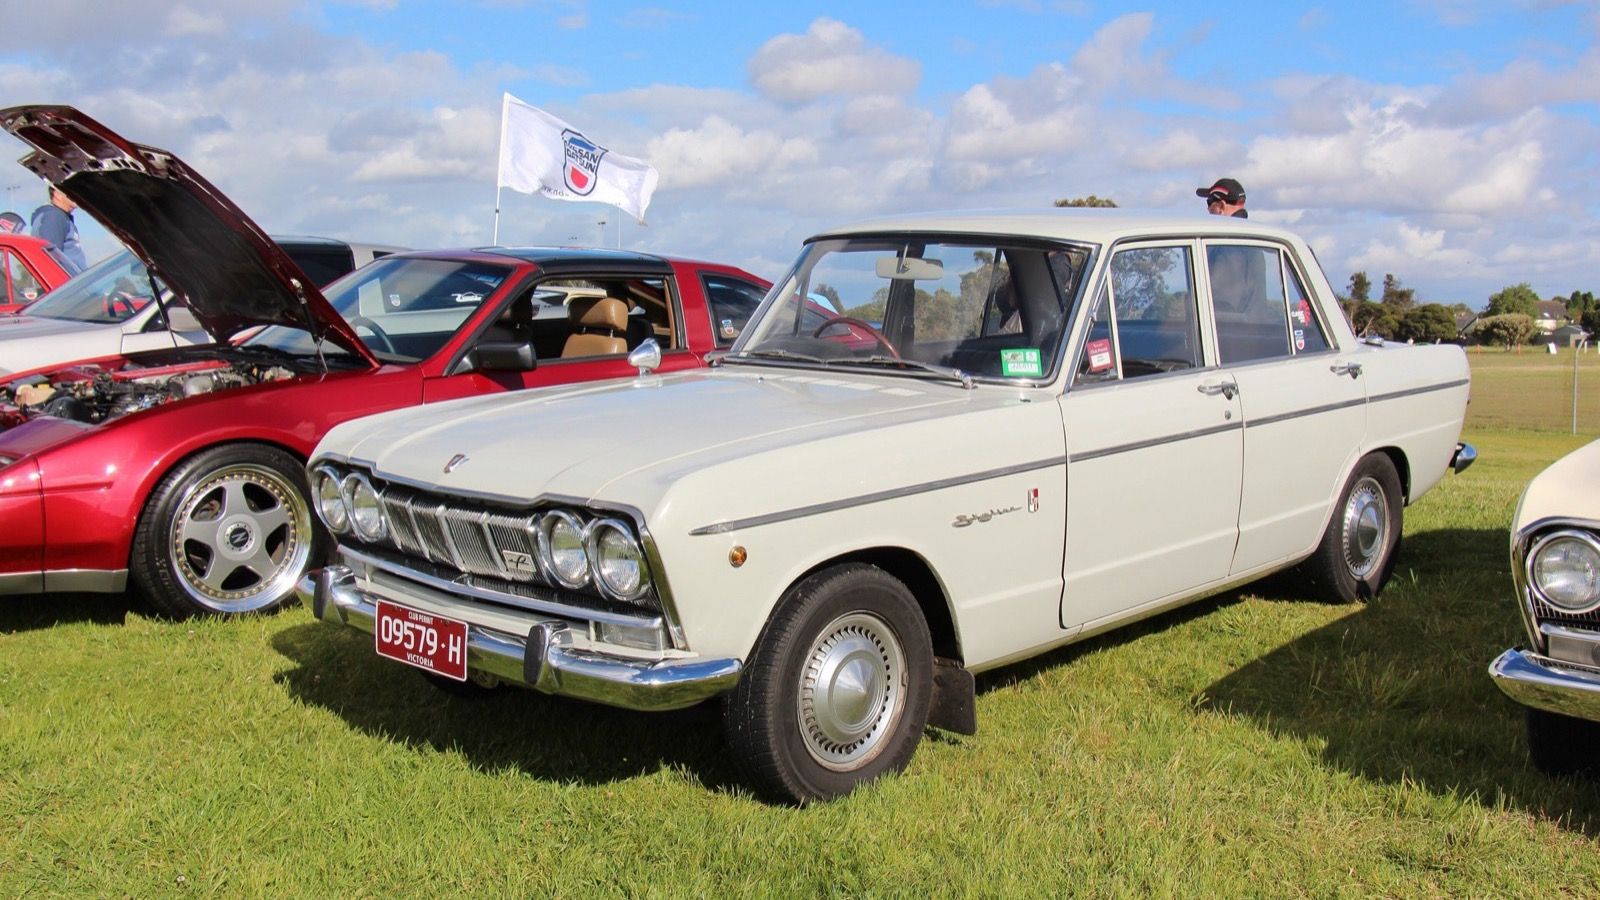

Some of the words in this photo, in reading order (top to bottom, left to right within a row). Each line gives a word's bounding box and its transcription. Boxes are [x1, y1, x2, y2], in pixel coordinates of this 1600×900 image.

[408, 611, 418, 620] CLUB
[418, 614, 433, 625] PERMIT
[381, 615, 438, 656] 09579
[407, 652, 433, 668] VICTORIA
